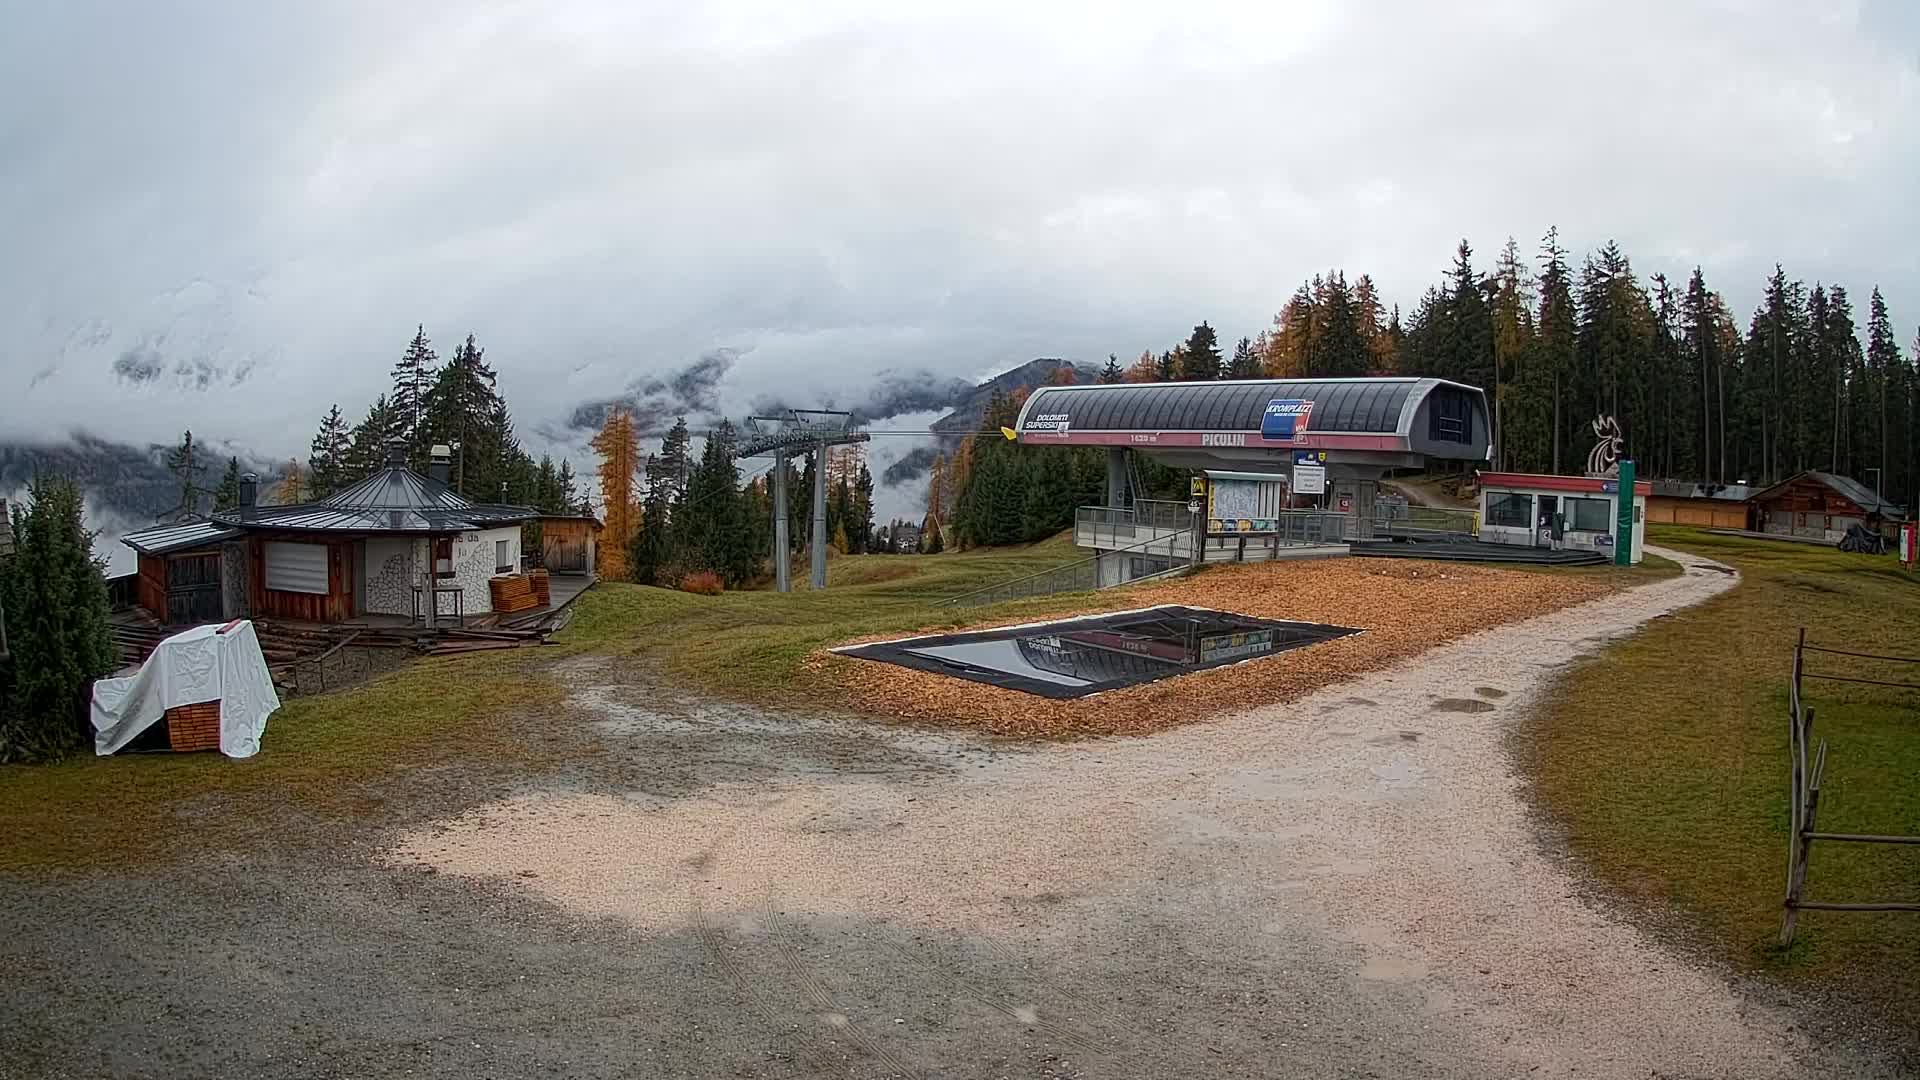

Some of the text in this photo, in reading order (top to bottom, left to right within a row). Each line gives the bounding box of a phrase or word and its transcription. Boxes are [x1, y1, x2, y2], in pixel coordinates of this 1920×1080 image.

[1266, 404, 1312, 413] KRONPLATZ
[1026, 421, 1058, 429] SUPERSKI
[1202, 433, 1245, 447] PICULIN
